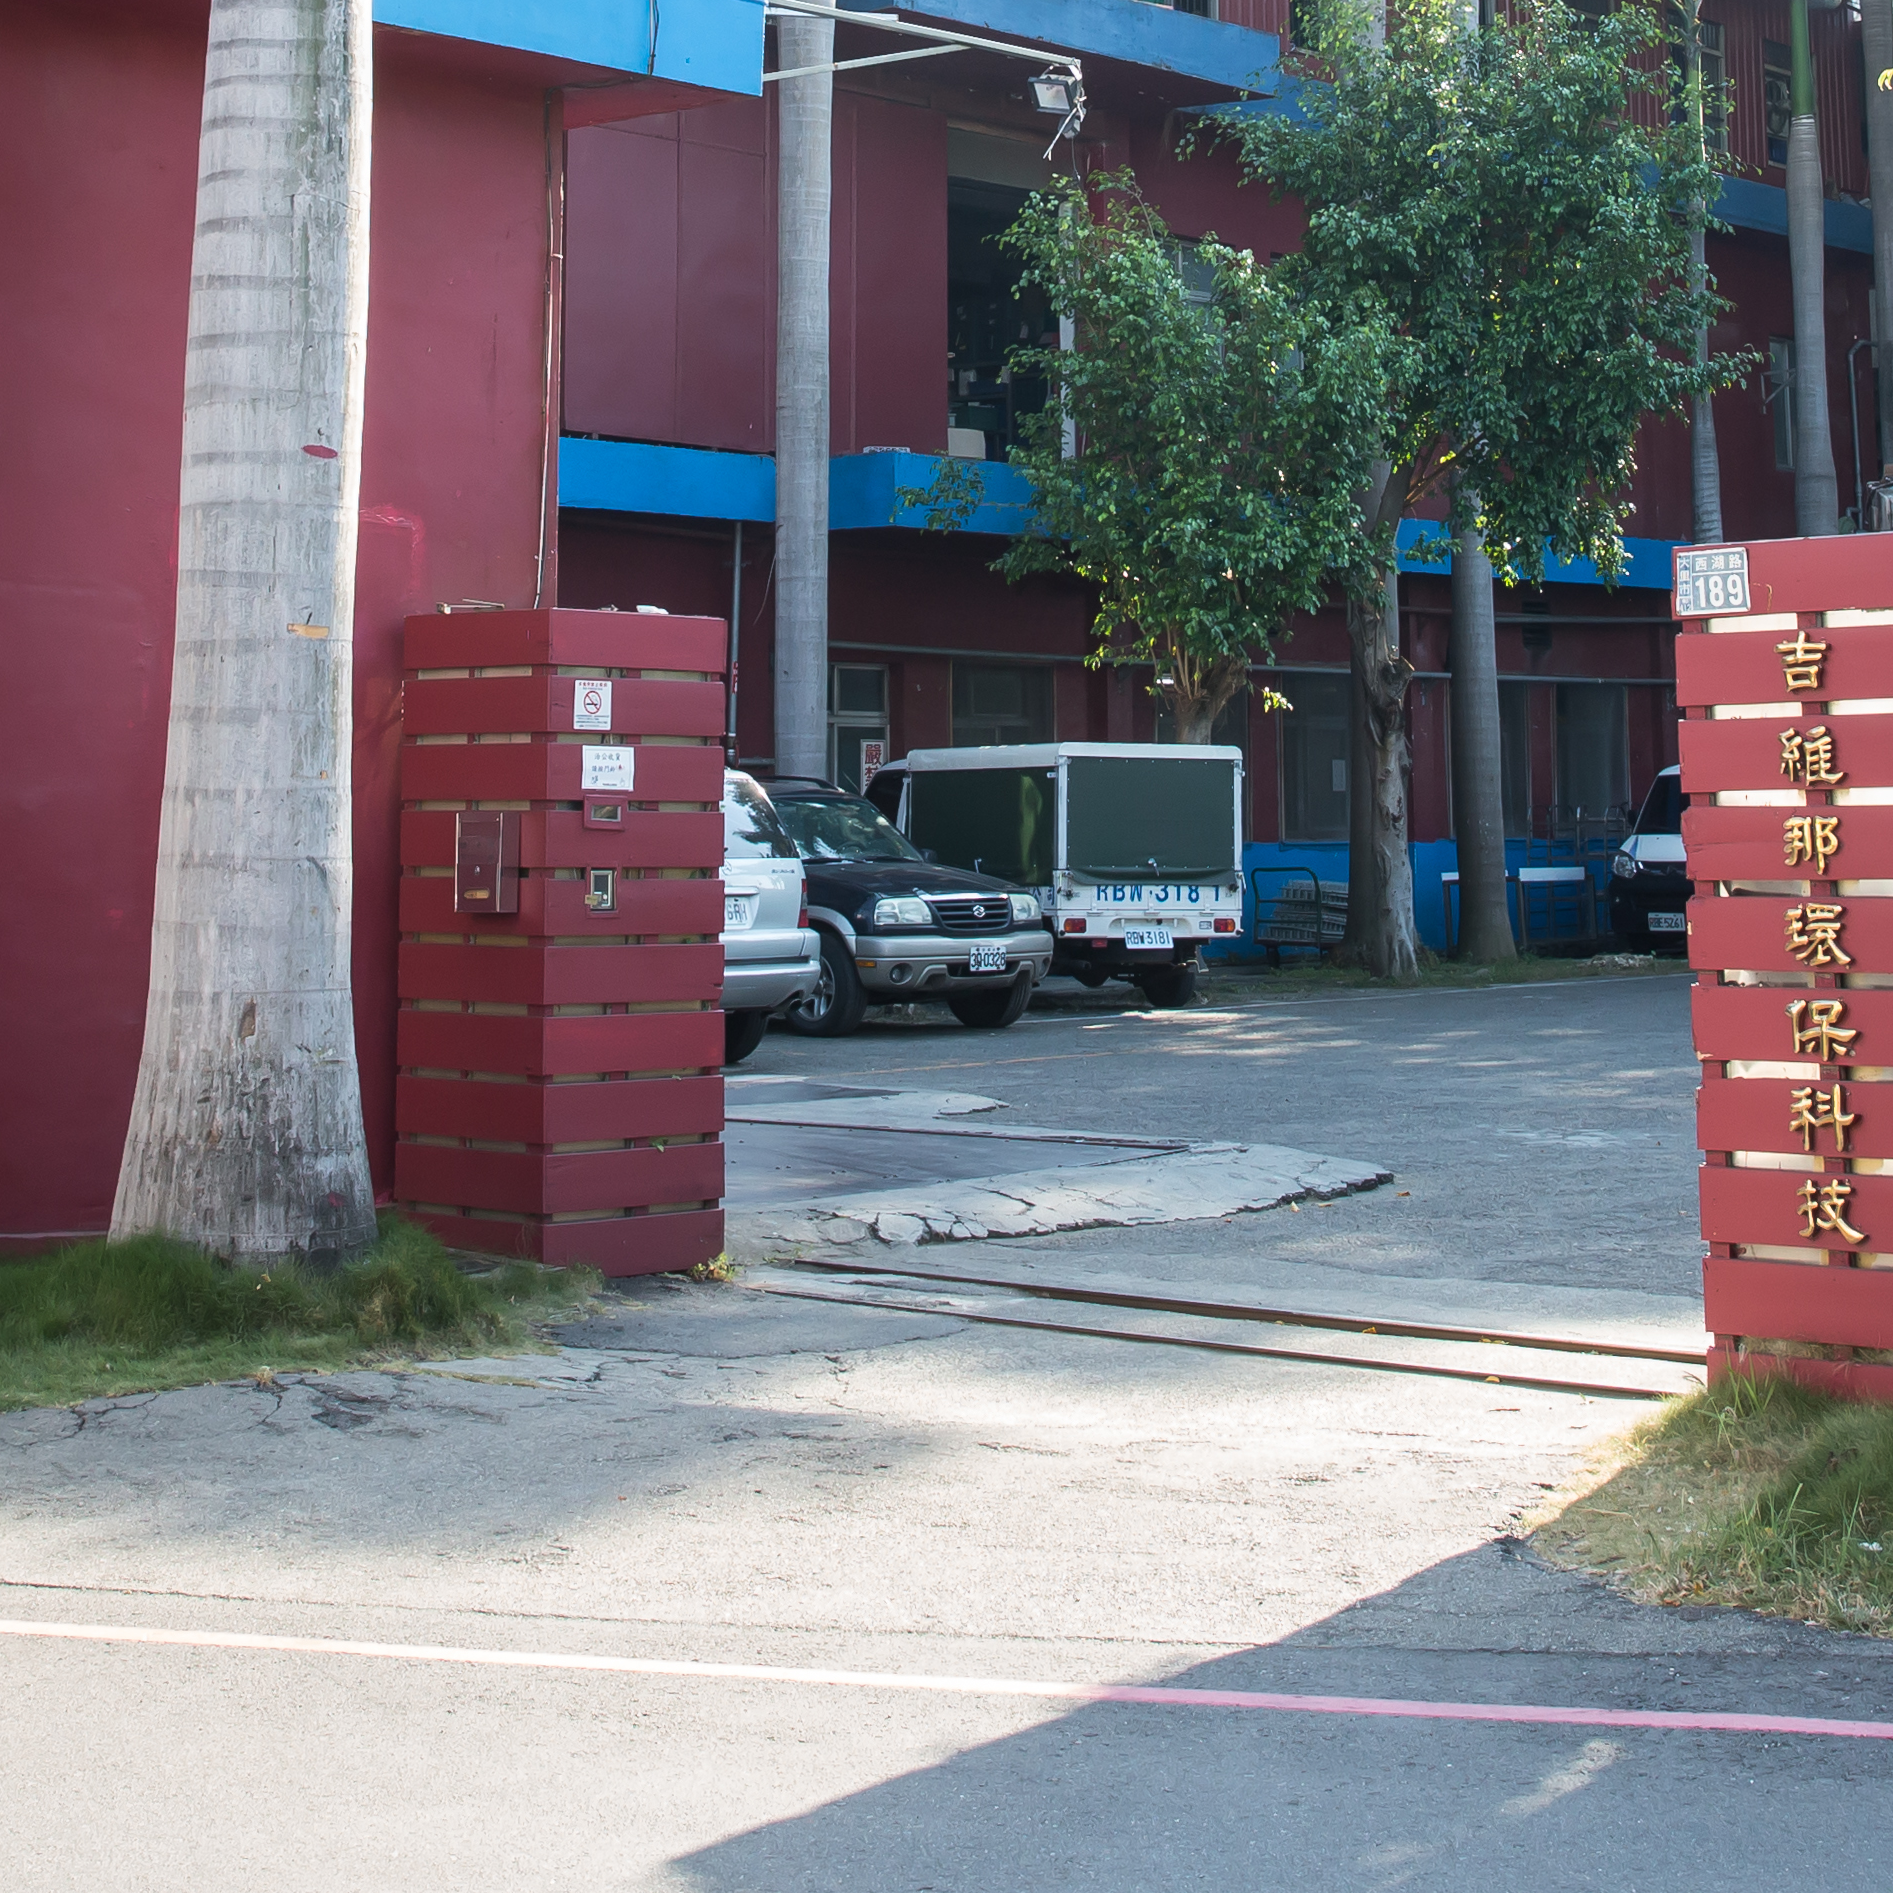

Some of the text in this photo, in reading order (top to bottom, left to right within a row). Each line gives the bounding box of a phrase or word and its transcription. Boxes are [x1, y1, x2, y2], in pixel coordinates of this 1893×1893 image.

[1695, 554, 1742, 571] 西湖路
[1695, 574, 1744, 608] 189
[1774, 631, 1869, 1245] 吉維那環保科技
